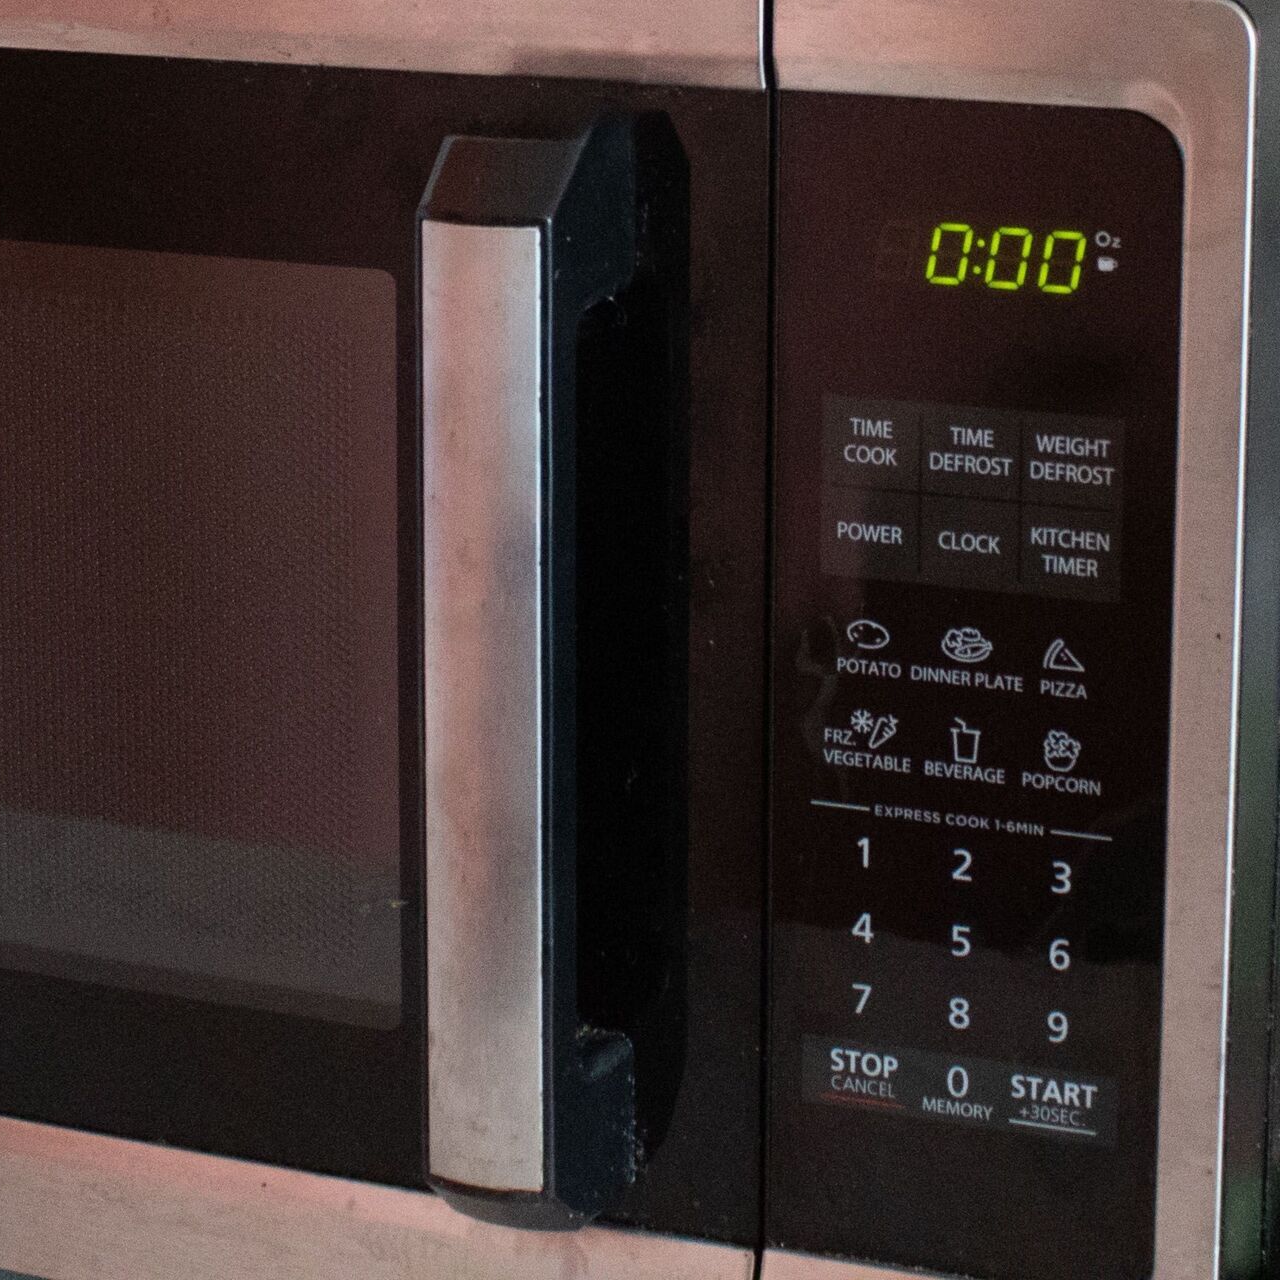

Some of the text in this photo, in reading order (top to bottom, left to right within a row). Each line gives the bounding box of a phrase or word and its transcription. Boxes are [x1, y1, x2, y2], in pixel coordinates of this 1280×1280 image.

[926, 223, 1086, 294] 0:00
[850, 418, 893, 439] TIME
[951, 427, 994, 448] TIME
[843, 446, 897, 466] COOK
[1036, 434, 1110, 458] WEIGHT
[929, 452, 1012, 477] DEFROST
[1029, 461, 1114, 486] DEFROST
[837, 522, 902, 544] POWER
[938, 531, 1000, 554] CLOCK
[1031, 527, 1110, 552] KITCHEN
[1041, 555, 1098, 577] TIMER
[836, 657, 901, 678] POTATO
[911, 666, 1024, 692] DINNER PLATE
[1040, 680, 1087, 699] PIZZA
[824, 728, 856, 746] FRZ.
[823, 749, 911, 773] VEGETABLE
[924, 761, 1005, 784] BEVERAGE
[1022, 772, 1101, 796] POPCORN
[874, 804, 1044, 837] EXPRESS COOK 1-6MIN
[857, 837, 870, 869] 1
[951, 849, 972, 881] 2
[1050, 861, 1072, 894] 3
[851, 912, 874, 944] 4
[951, 925, 971, 957] 5
[1048, 939, 1070, 970] 6
[852, 983, 872, 1014] 7
[948, 997, 970, 1030] 8
[1047, 1011, 1069, 1043] 9
[830, 1048, 899, 1078] STOP
[831, 1076, 896, 1099] CANCEL
[946, 1066, 969, 1099] 0
[1010, 1075, 1098, 1108] START
[922, 1097, 993, 1120] MEMORY
